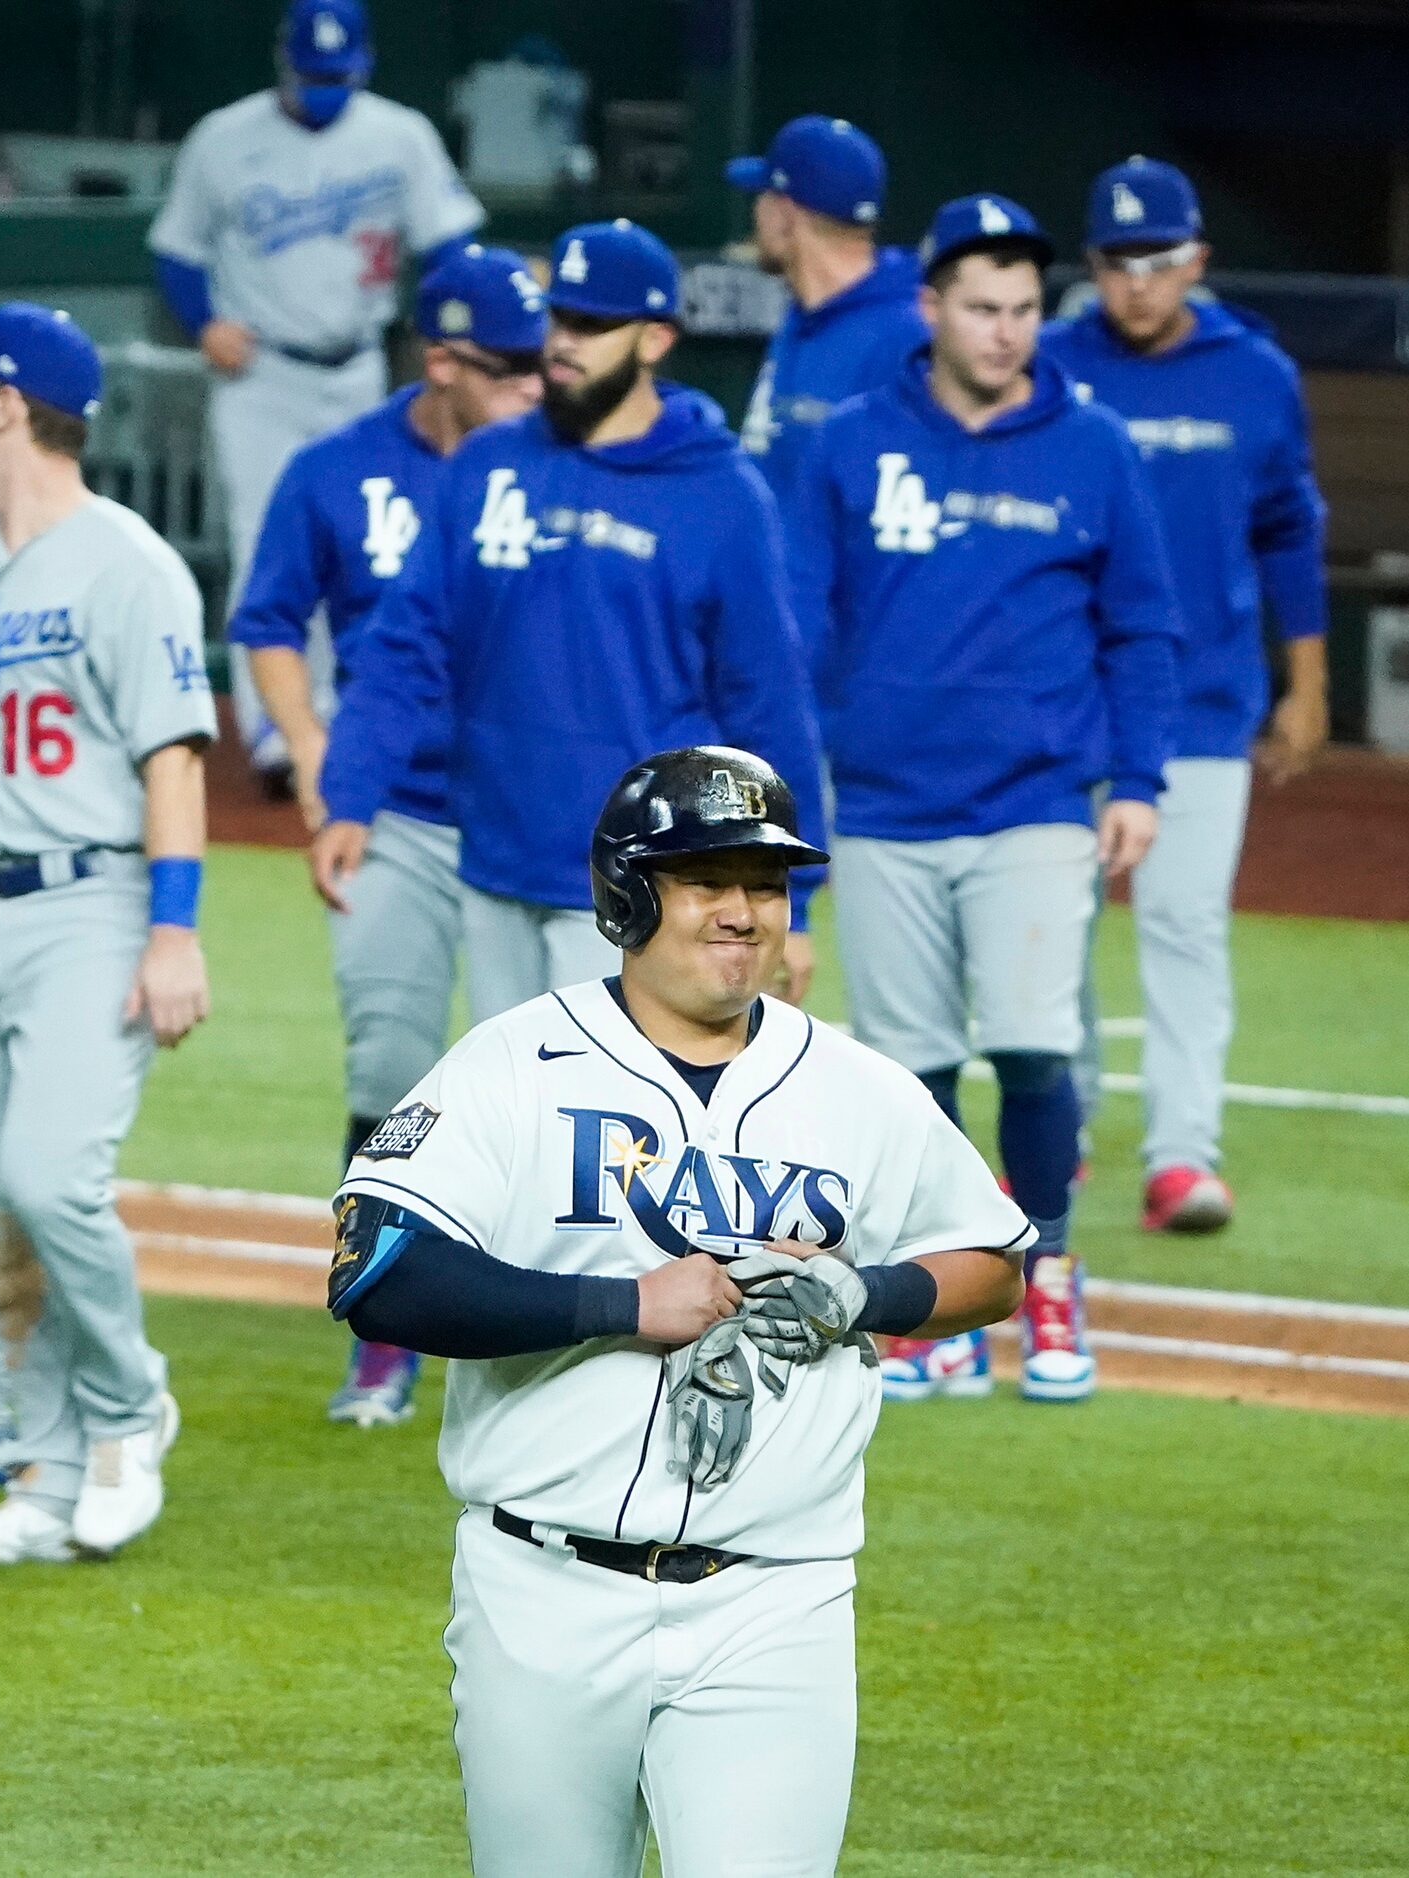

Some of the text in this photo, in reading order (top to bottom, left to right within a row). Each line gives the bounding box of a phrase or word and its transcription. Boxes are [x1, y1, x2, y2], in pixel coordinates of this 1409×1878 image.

[473, 468, 538, 569] LA
[871, 452, 942, 554] LA
[0, 689, 76, 777] 16
[363, 1134, 424, 1152] SERIES
[379, 1117, 435, 1135] WORLD
[553, 1106, 854, 1261] RAYS
